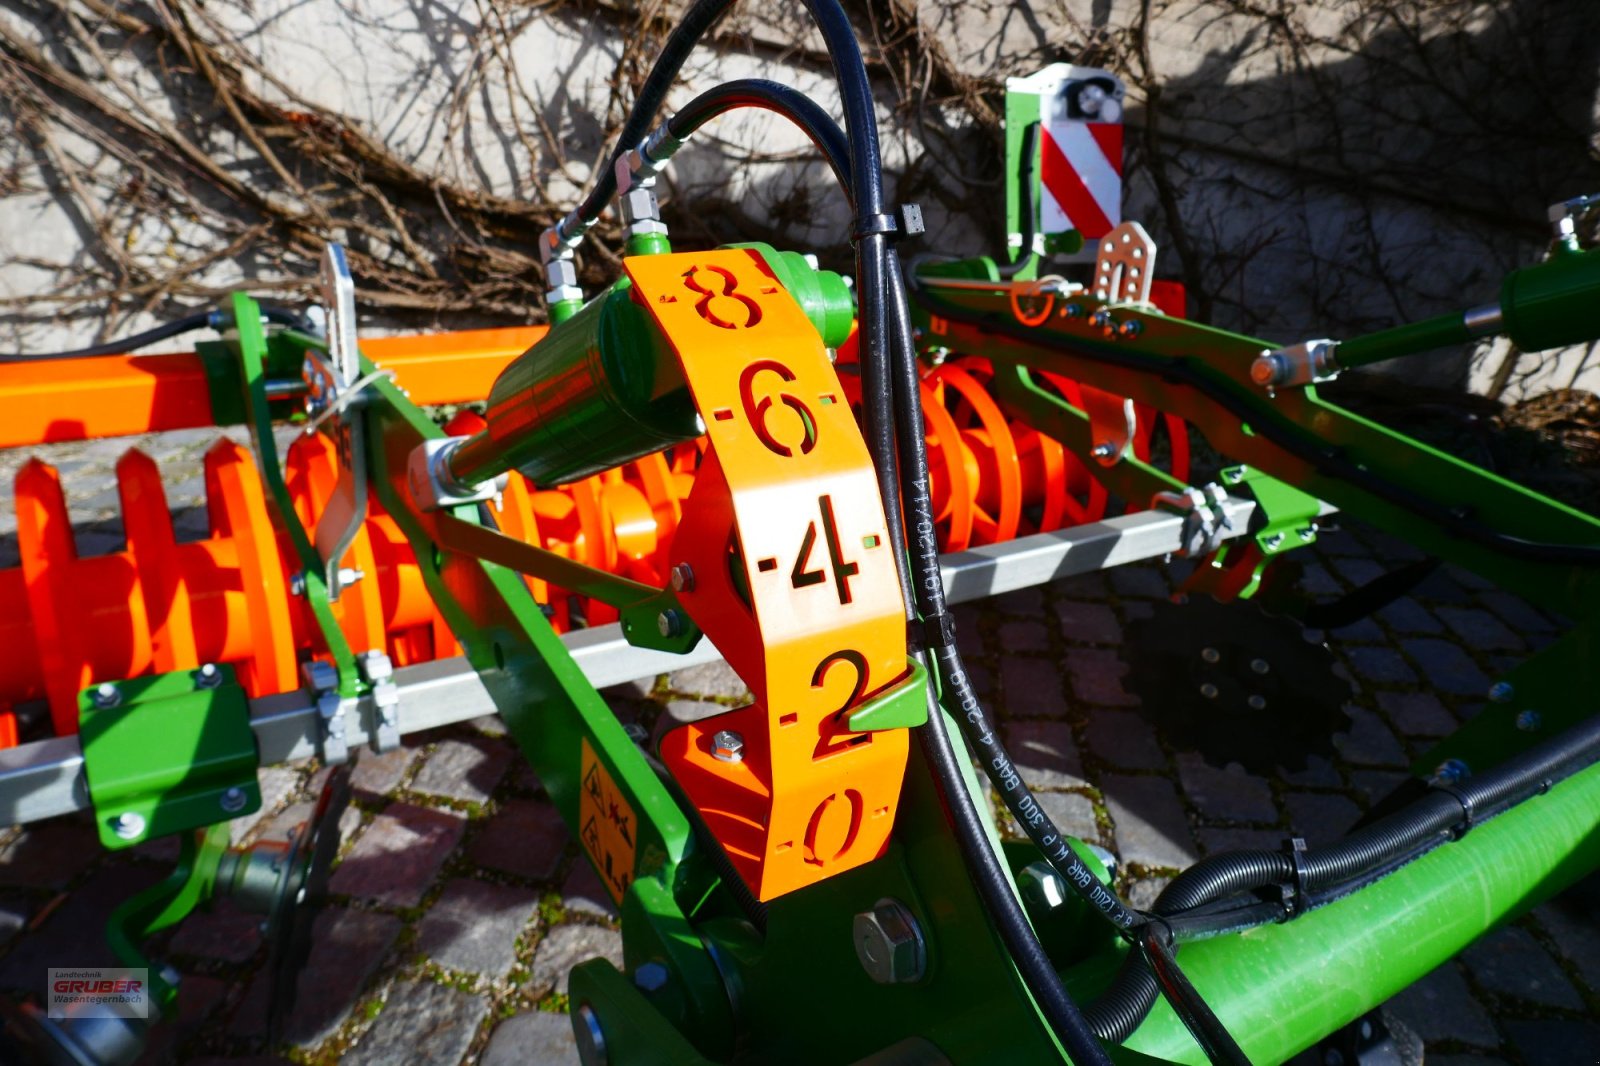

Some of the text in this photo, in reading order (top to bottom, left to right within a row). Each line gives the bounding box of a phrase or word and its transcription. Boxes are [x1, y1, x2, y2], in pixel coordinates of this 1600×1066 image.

[681, 264, 763, 330] 8
[739, 359, 818, 457] 6
[791, 495, 860, 605] 4
[810, 649, 873, 762] 2
[950, 670, 993, 745] 4-2019
[992, 752, 1020, 791] BAR
[803, 788, 864, 867] 0
[1067, 860, 1092, 888] BAR
